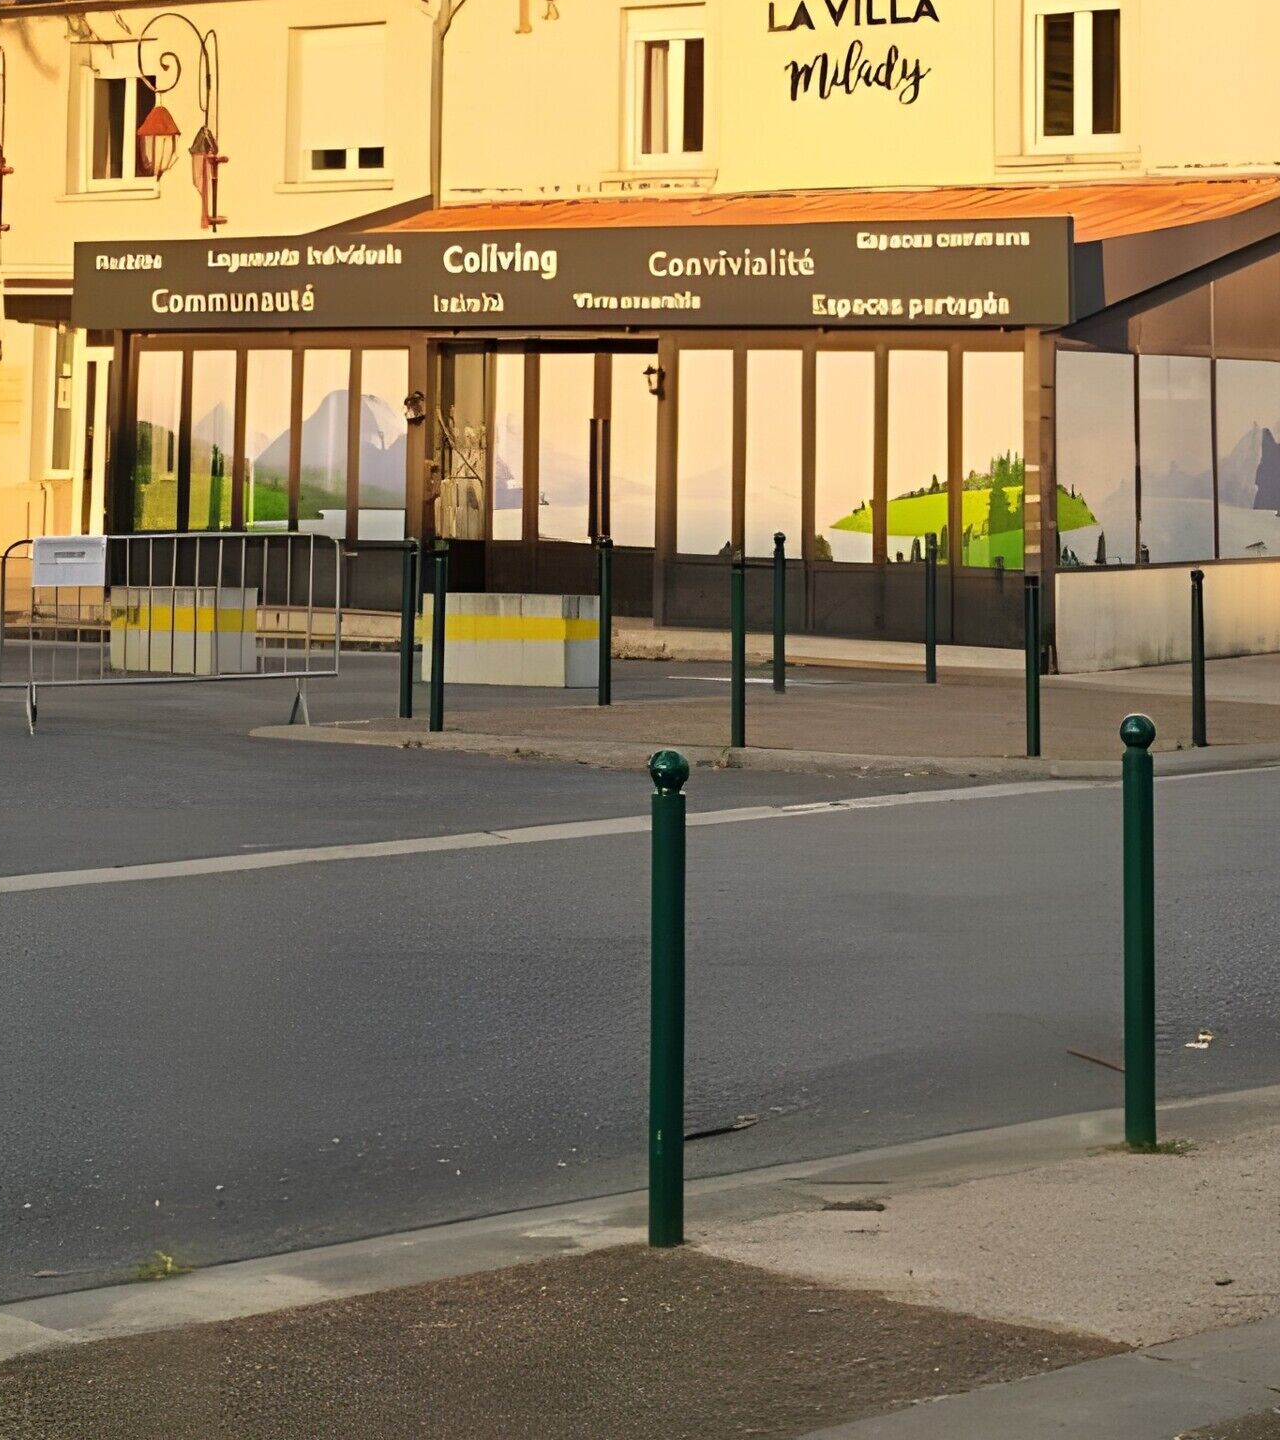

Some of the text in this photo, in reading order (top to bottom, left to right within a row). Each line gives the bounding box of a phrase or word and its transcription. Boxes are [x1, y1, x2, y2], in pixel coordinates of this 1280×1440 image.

[768, 0, 816, 32] LA
[784, 39, 932, 105] Milady
[648, 247, 816, 277] Convivialité
[151, 284, 315, 314] Communauté
